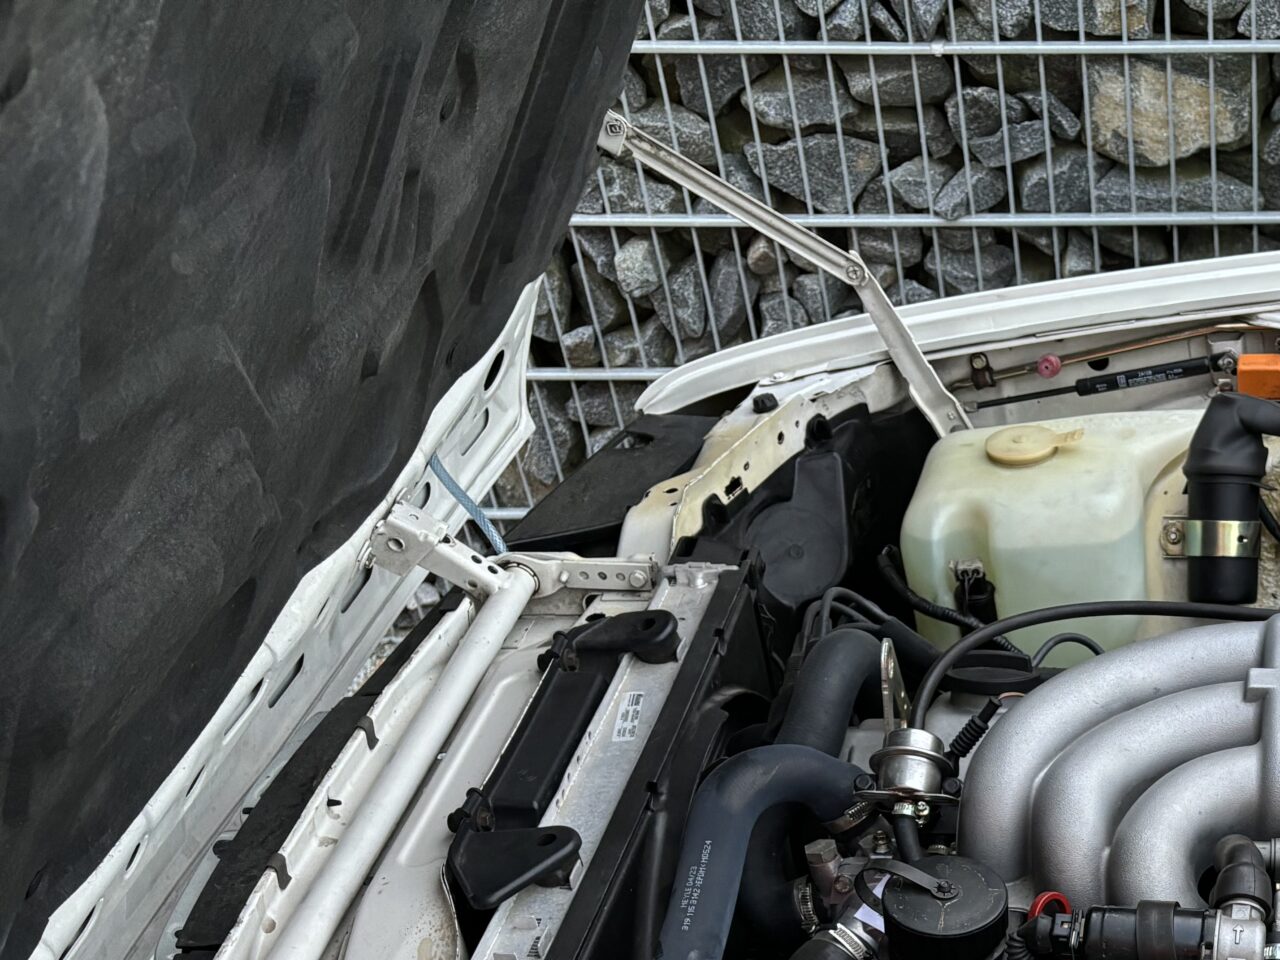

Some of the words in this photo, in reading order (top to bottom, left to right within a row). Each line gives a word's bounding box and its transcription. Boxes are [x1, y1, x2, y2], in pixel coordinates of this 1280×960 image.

[680, 887, 691, 907] MEYLE
[686, 865, 697, 886] 04/23
[681, 917, 690, 930] 319
[686, 905, 695, 916] 115
